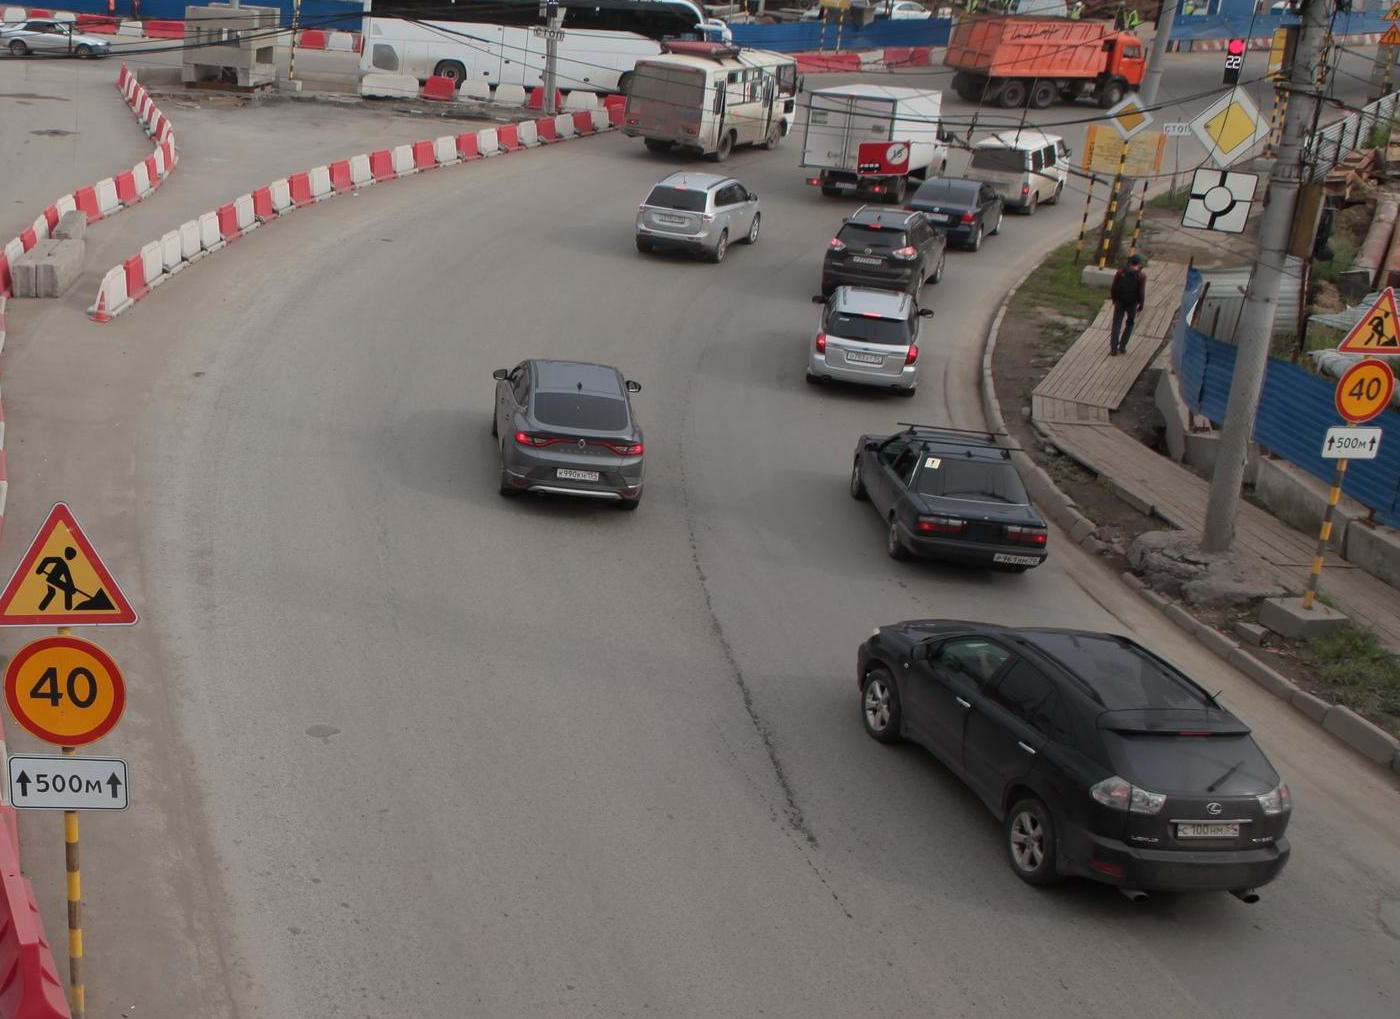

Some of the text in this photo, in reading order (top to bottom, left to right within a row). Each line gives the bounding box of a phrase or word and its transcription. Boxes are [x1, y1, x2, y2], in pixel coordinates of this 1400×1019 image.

[1225, 56, 1241, 68] 22
[1348, 377, 1381, 400] 40
[29, 667, 98, 708] 40
